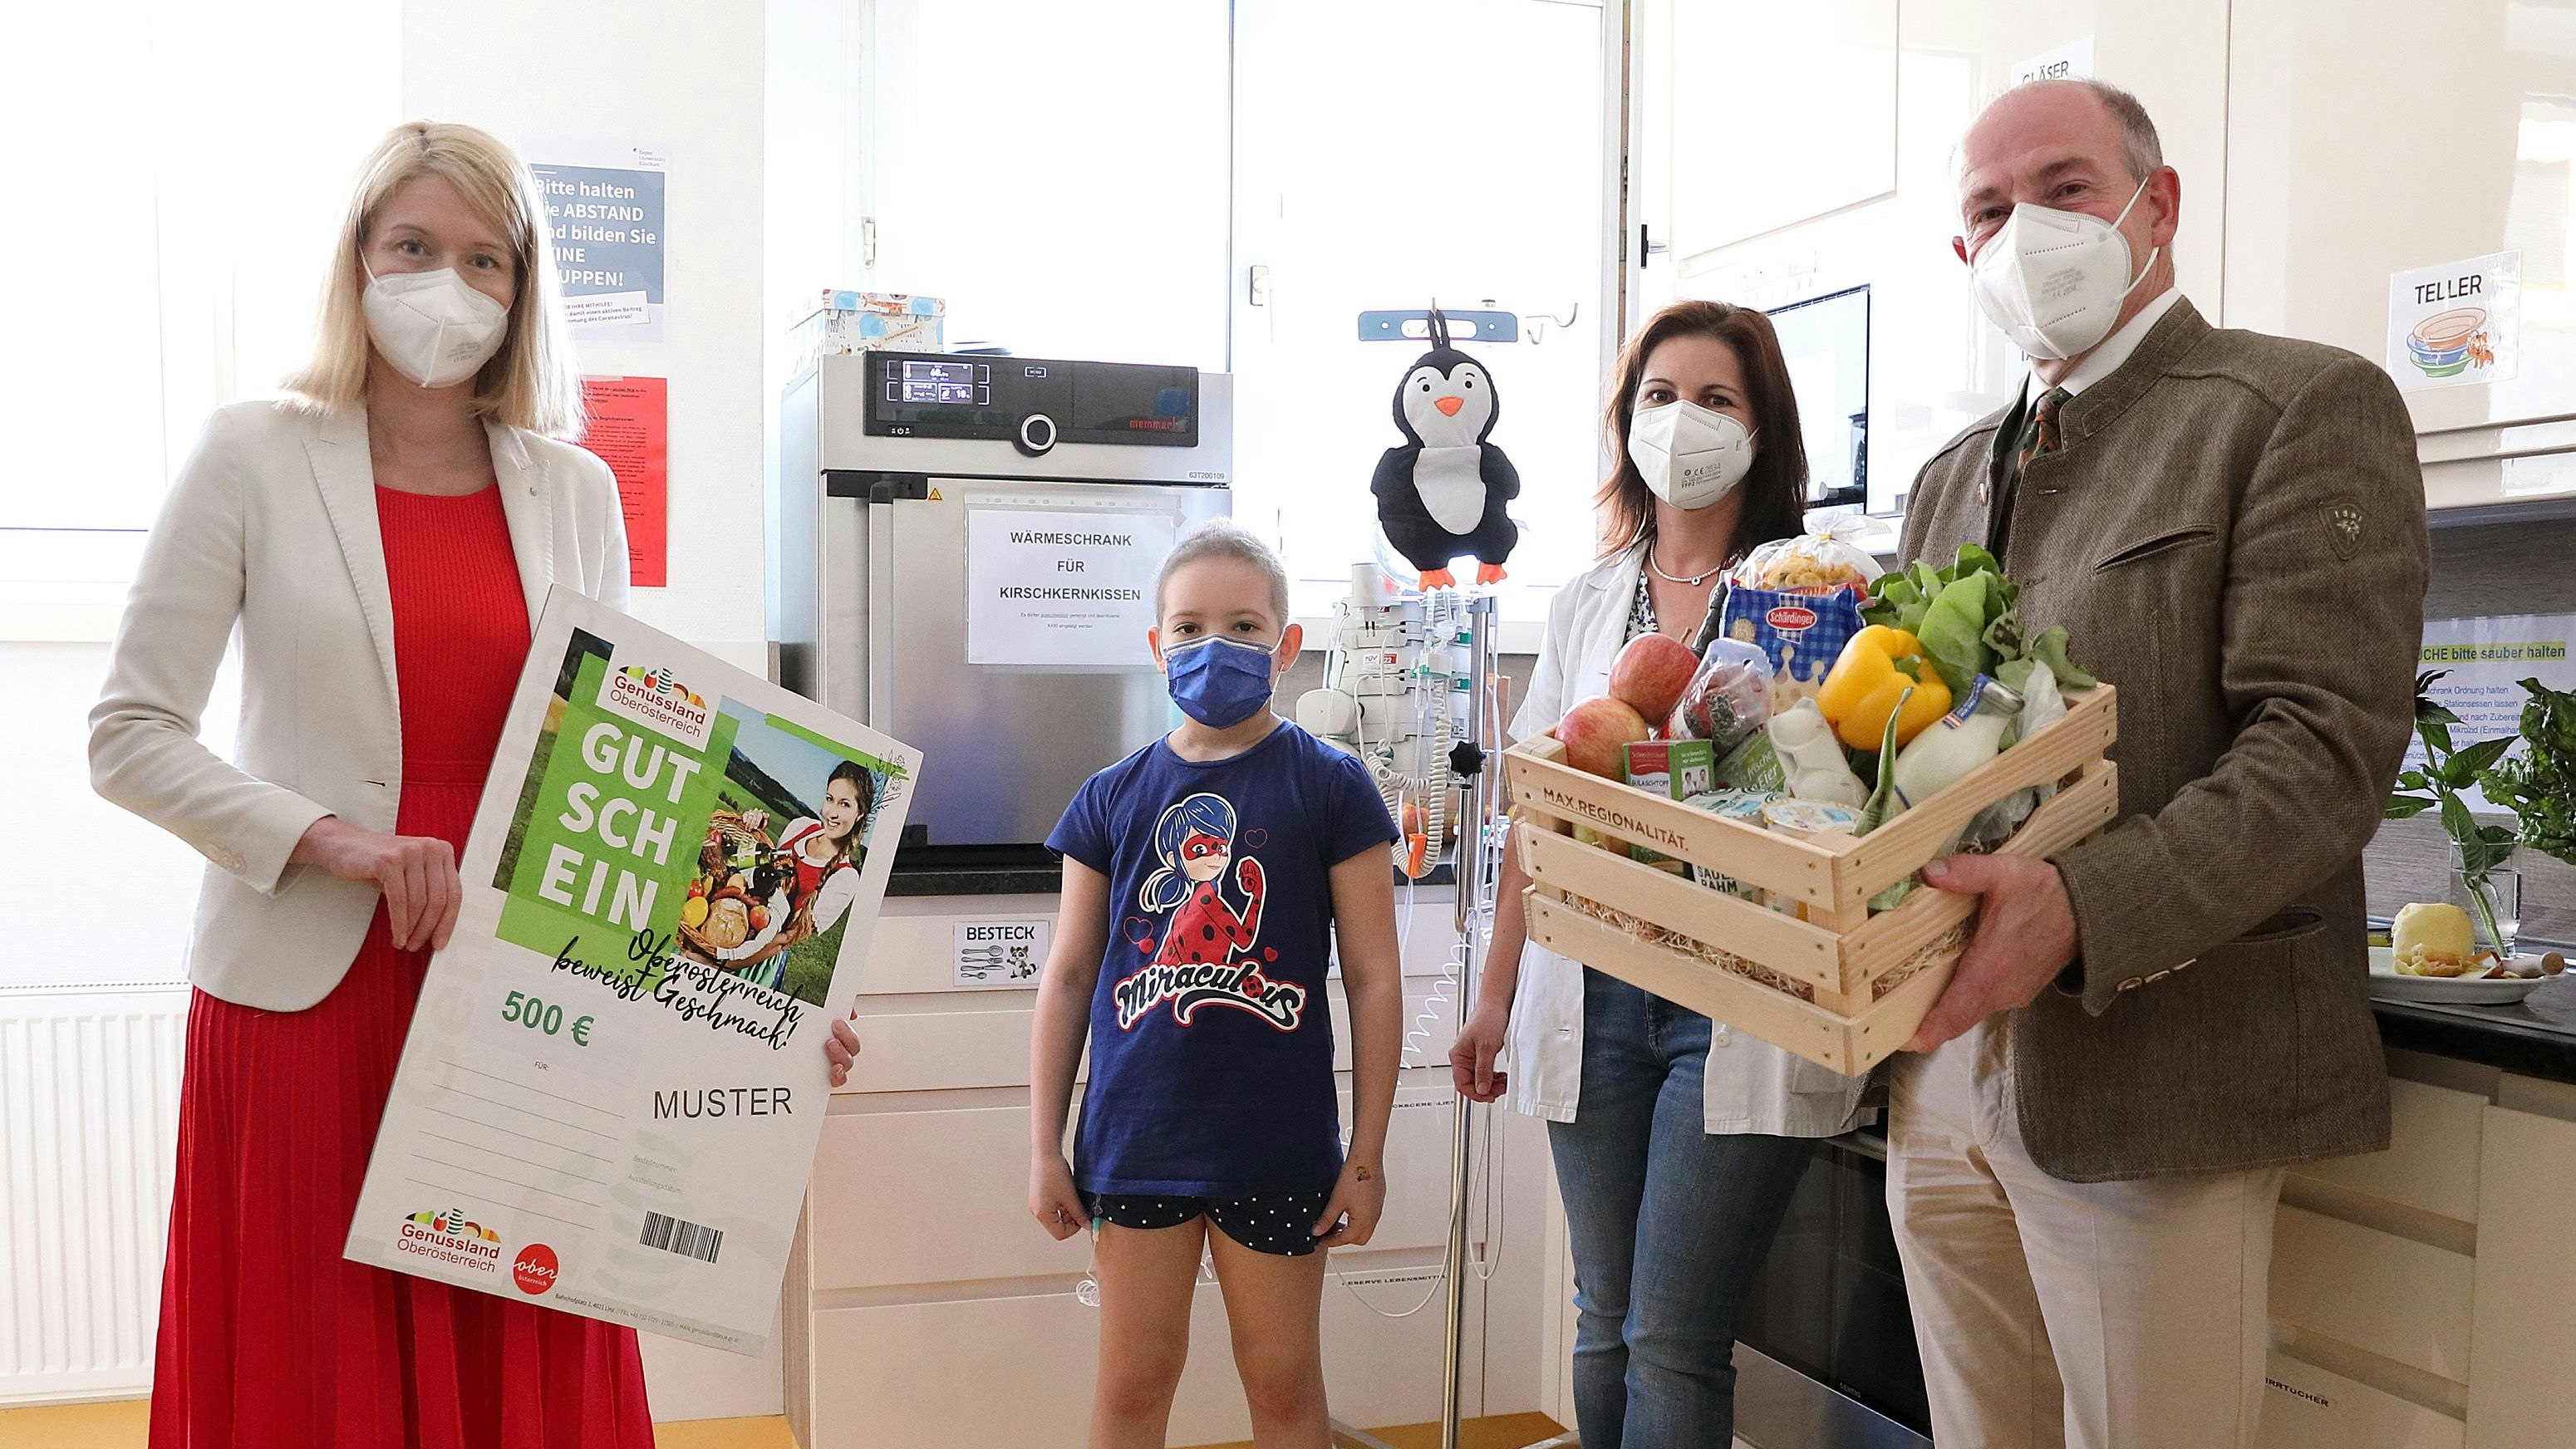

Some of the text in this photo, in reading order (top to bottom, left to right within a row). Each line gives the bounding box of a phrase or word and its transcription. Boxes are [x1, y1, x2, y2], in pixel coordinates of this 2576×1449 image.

[579, 180, 634, 199] halten
[544, 200, 644, 222] ie ABSTAND
[549, 223, 656, 244] nd bilden Sie
[554, 247, 586, 263] INE
[558, 268, 624, 287] UPPEN!
[2415, 274, 2482, 304] TELLER
[597, 313, 632, 322] Coronavirus!
[1010, 529, 1132, 547] WÄRMESCHRANK
[1057, 557, 1085, 572] FÜR
[1000, 587, 1141, 601] KIRSCHKERNKISSEN
[1769, 612, 1814, 625] Schärdinger
[2419, 645, 2565, 661] CHE bitte sauber halten
[614, 675, 705, 724] Genussland
[2426, 685, 2509, 696] schrank Ordnung halten
[610, 689, 701, 738] Oberösterreich
[2444, 699, 2491, 708] Stationsessen
[2493, 699, 2518, 707] lassen
[2470, 713, 2488, 721] nach
[2490, 711, 2520, 721] Zubereit
[582, 722, 701, 804] GUT
[558, 782, 678, 867] SCH
[538, 843, 659, 931] EIN
[966, 925, 1035, 941] BESTECK
[551, 935, 798, 1051] beweist Geschmack!
[1117, 962, 1305, 1028] Miraculous
[501, 990, 595, 1048] 500 €
[653, 1086, 793, 1119] MUSTER
[401, 1224, 500, 1259] Genussland
[397, 1238, 496, 1273] Oberösterreich
[514, 1258, 558, 1280] ober
[518, 1275, 548, 1287] österreich
